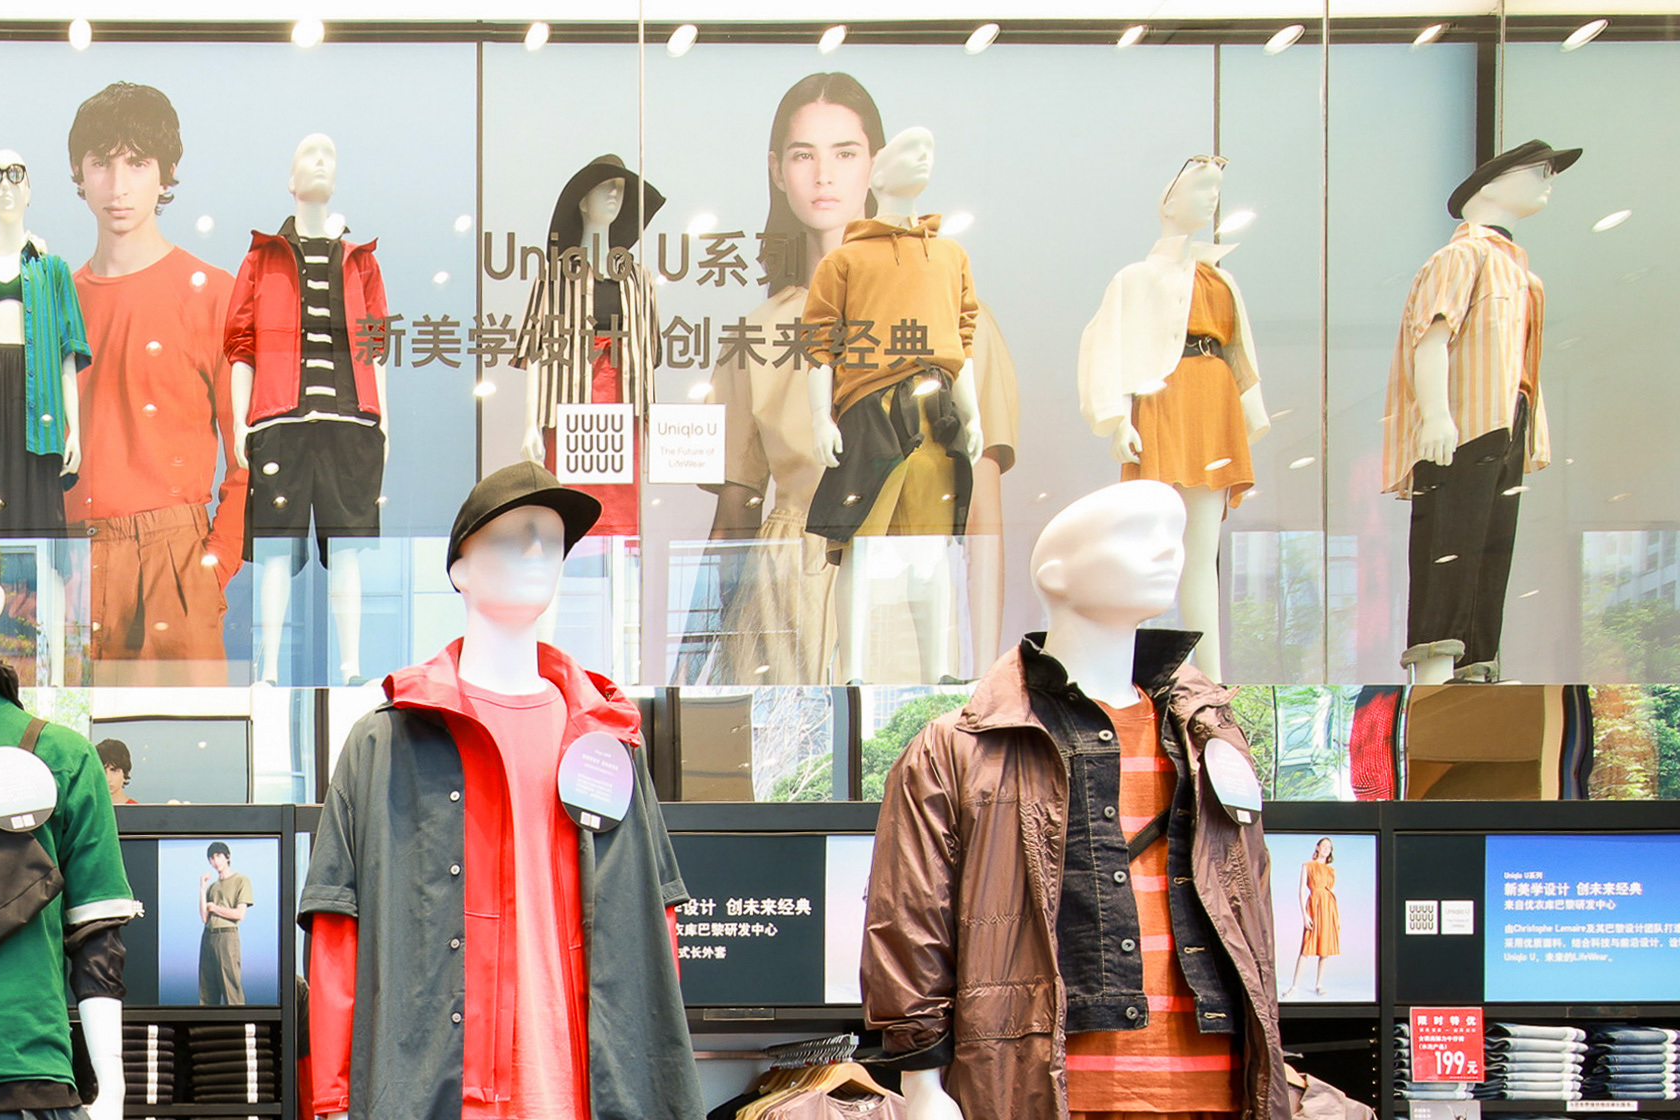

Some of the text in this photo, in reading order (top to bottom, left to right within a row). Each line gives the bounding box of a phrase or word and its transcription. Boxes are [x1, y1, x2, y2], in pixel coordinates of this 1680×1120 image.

[483, 230, 807, 288] Uniqlo U系列
[354, 312, 936, 372] 新美学设计 创未来经典
[657, 422, 717, 438] Uniqlo U
[1504, 882, 1643, 896] 新美学设计 创未来经典
[726, 898, 812, 916] 创未来经典
[1504, 899, 1616, 910] 来自优衣库巴黎研发中心
